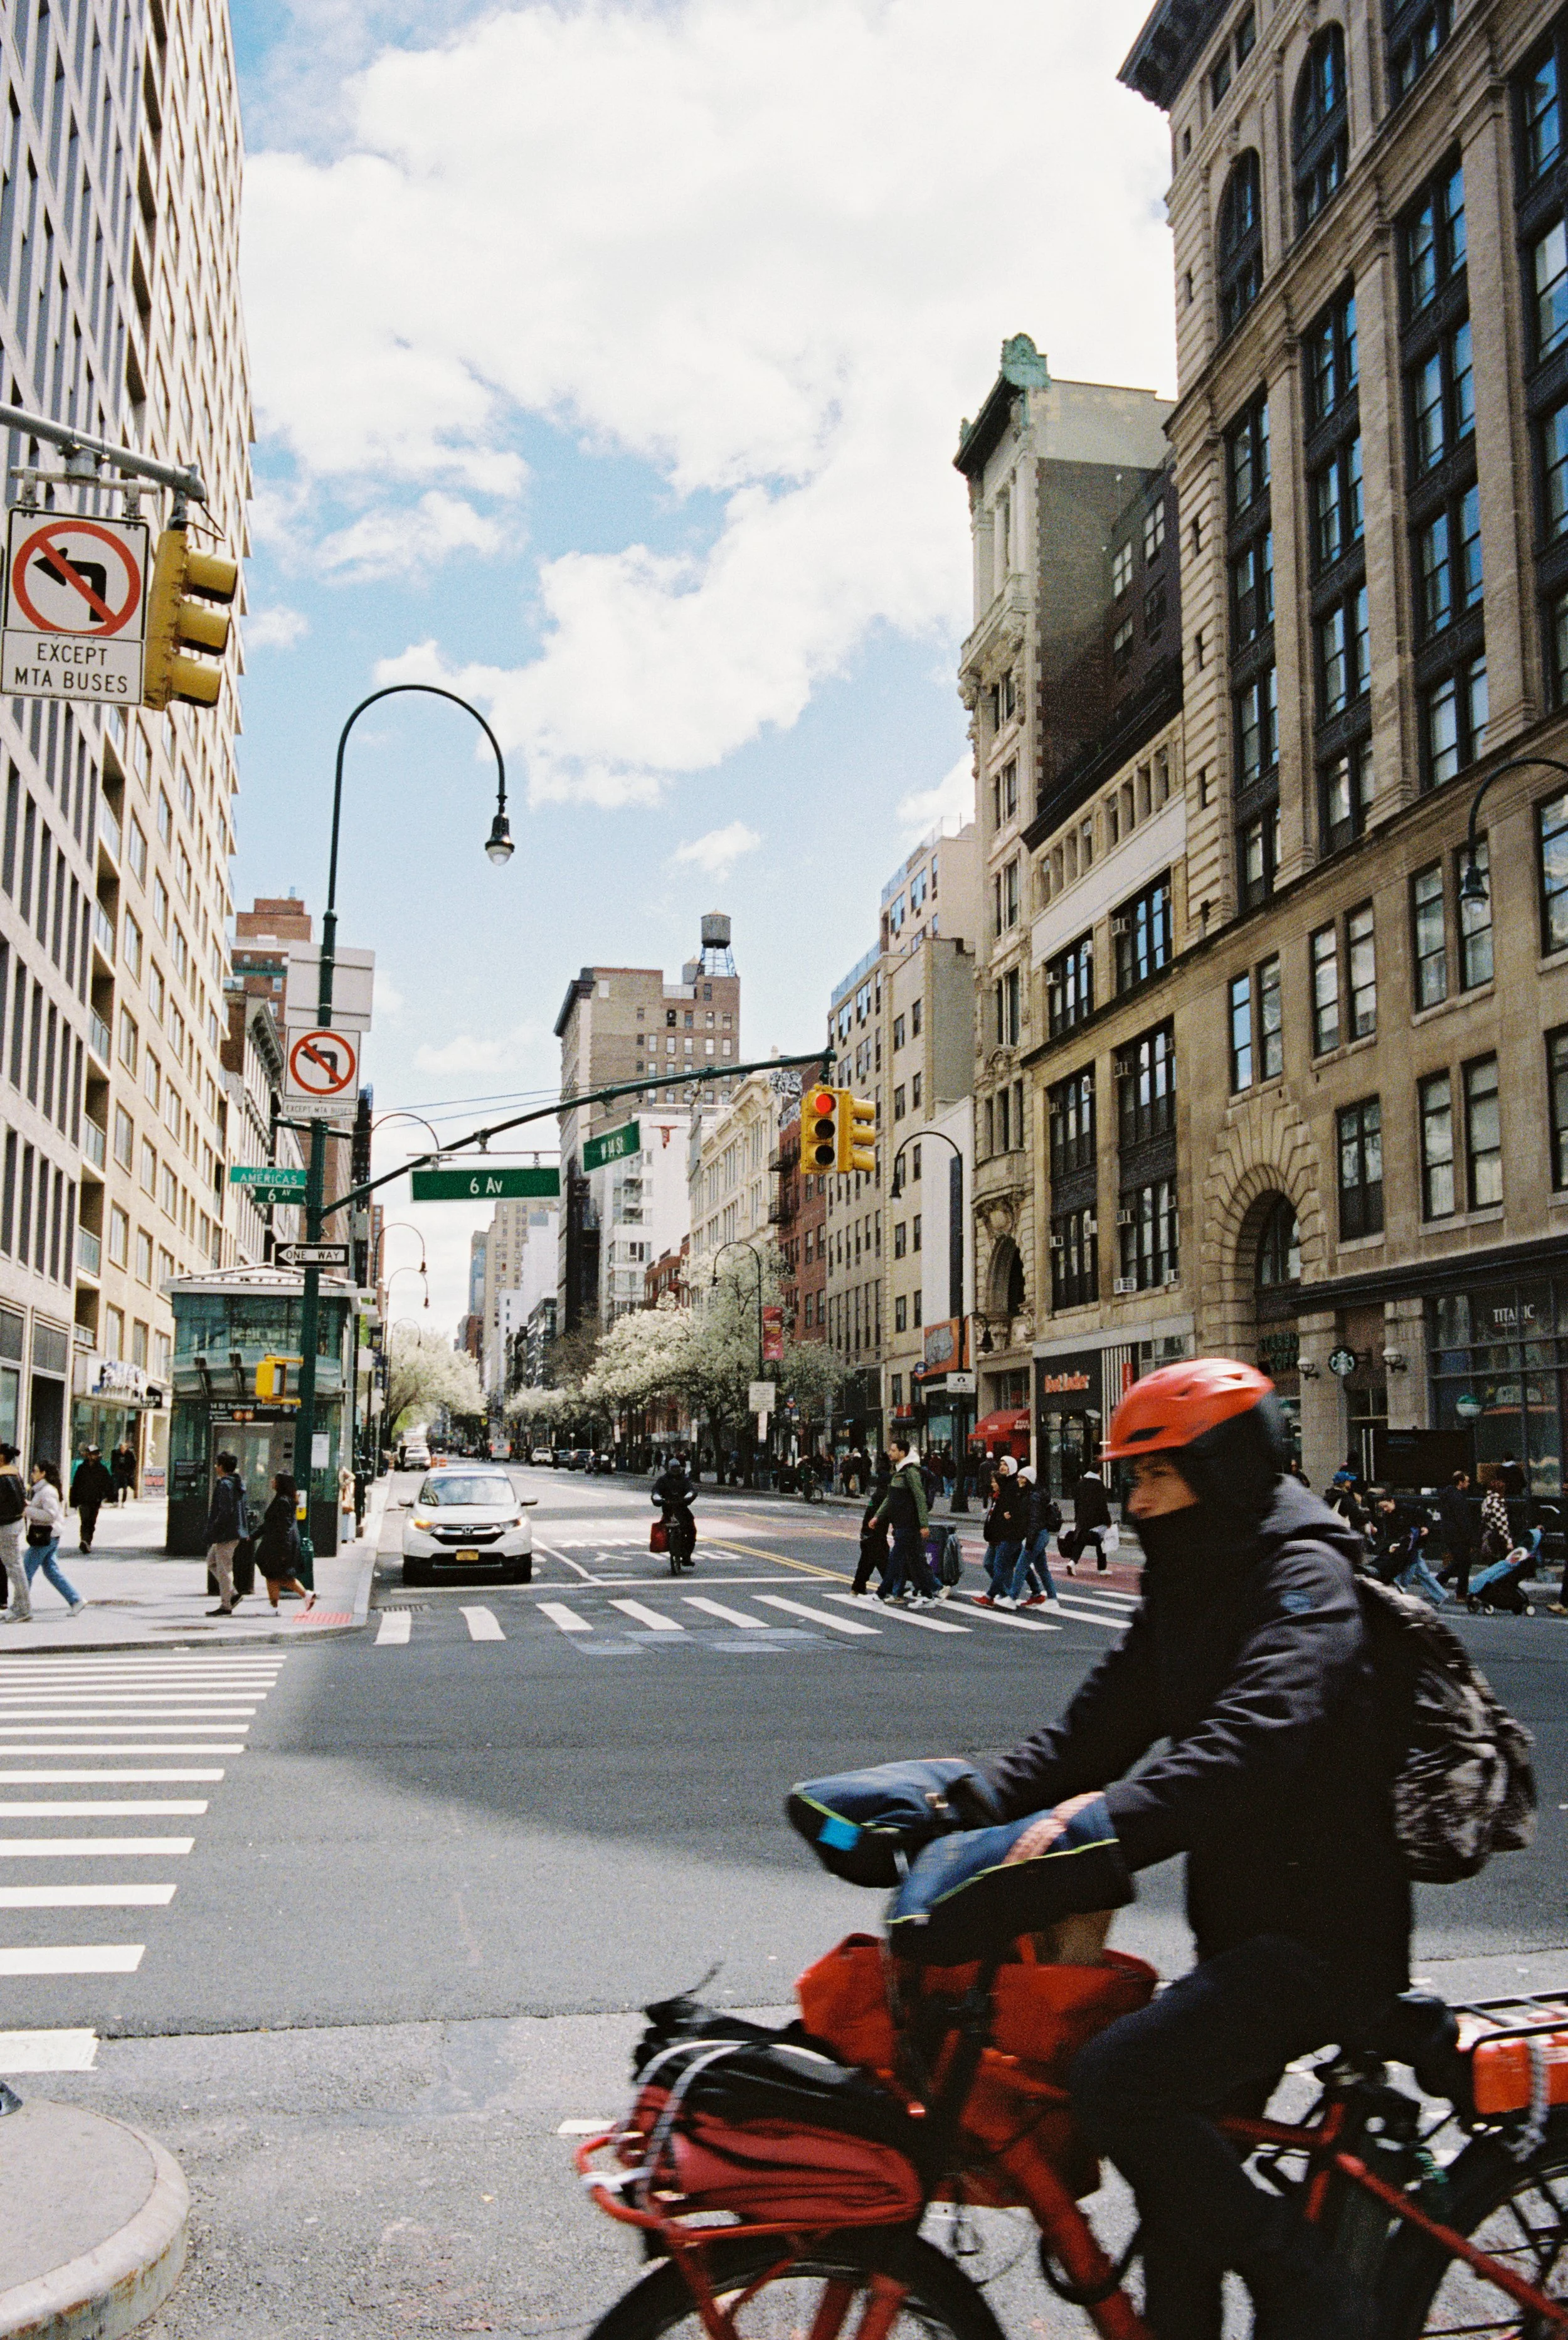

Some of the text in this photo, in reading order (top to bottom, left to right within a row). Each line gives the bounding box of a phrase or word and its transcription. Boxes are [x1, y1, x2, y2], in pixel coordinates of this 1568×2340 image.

[37, 642, 108, 666] EXCEPT
[14, 666, 128, 694] MTA BUSES
[285, 1105, 311, 1113] EXCEPT
[331, 1107, 352, 1115] BUSES
[600, 1135, 624, 1161] W 14 St
[240, 1173, 298, 1185] AMERICAS
[469, 1176, 503, 1194] 6 Av
[267, 1188, 277, 1203] 6
[285, 1249, 339, 1260] ONE WAY
[1258, 1331, 1299, 1352] STARBU
[227, 1402, 255, 1411] Subway
